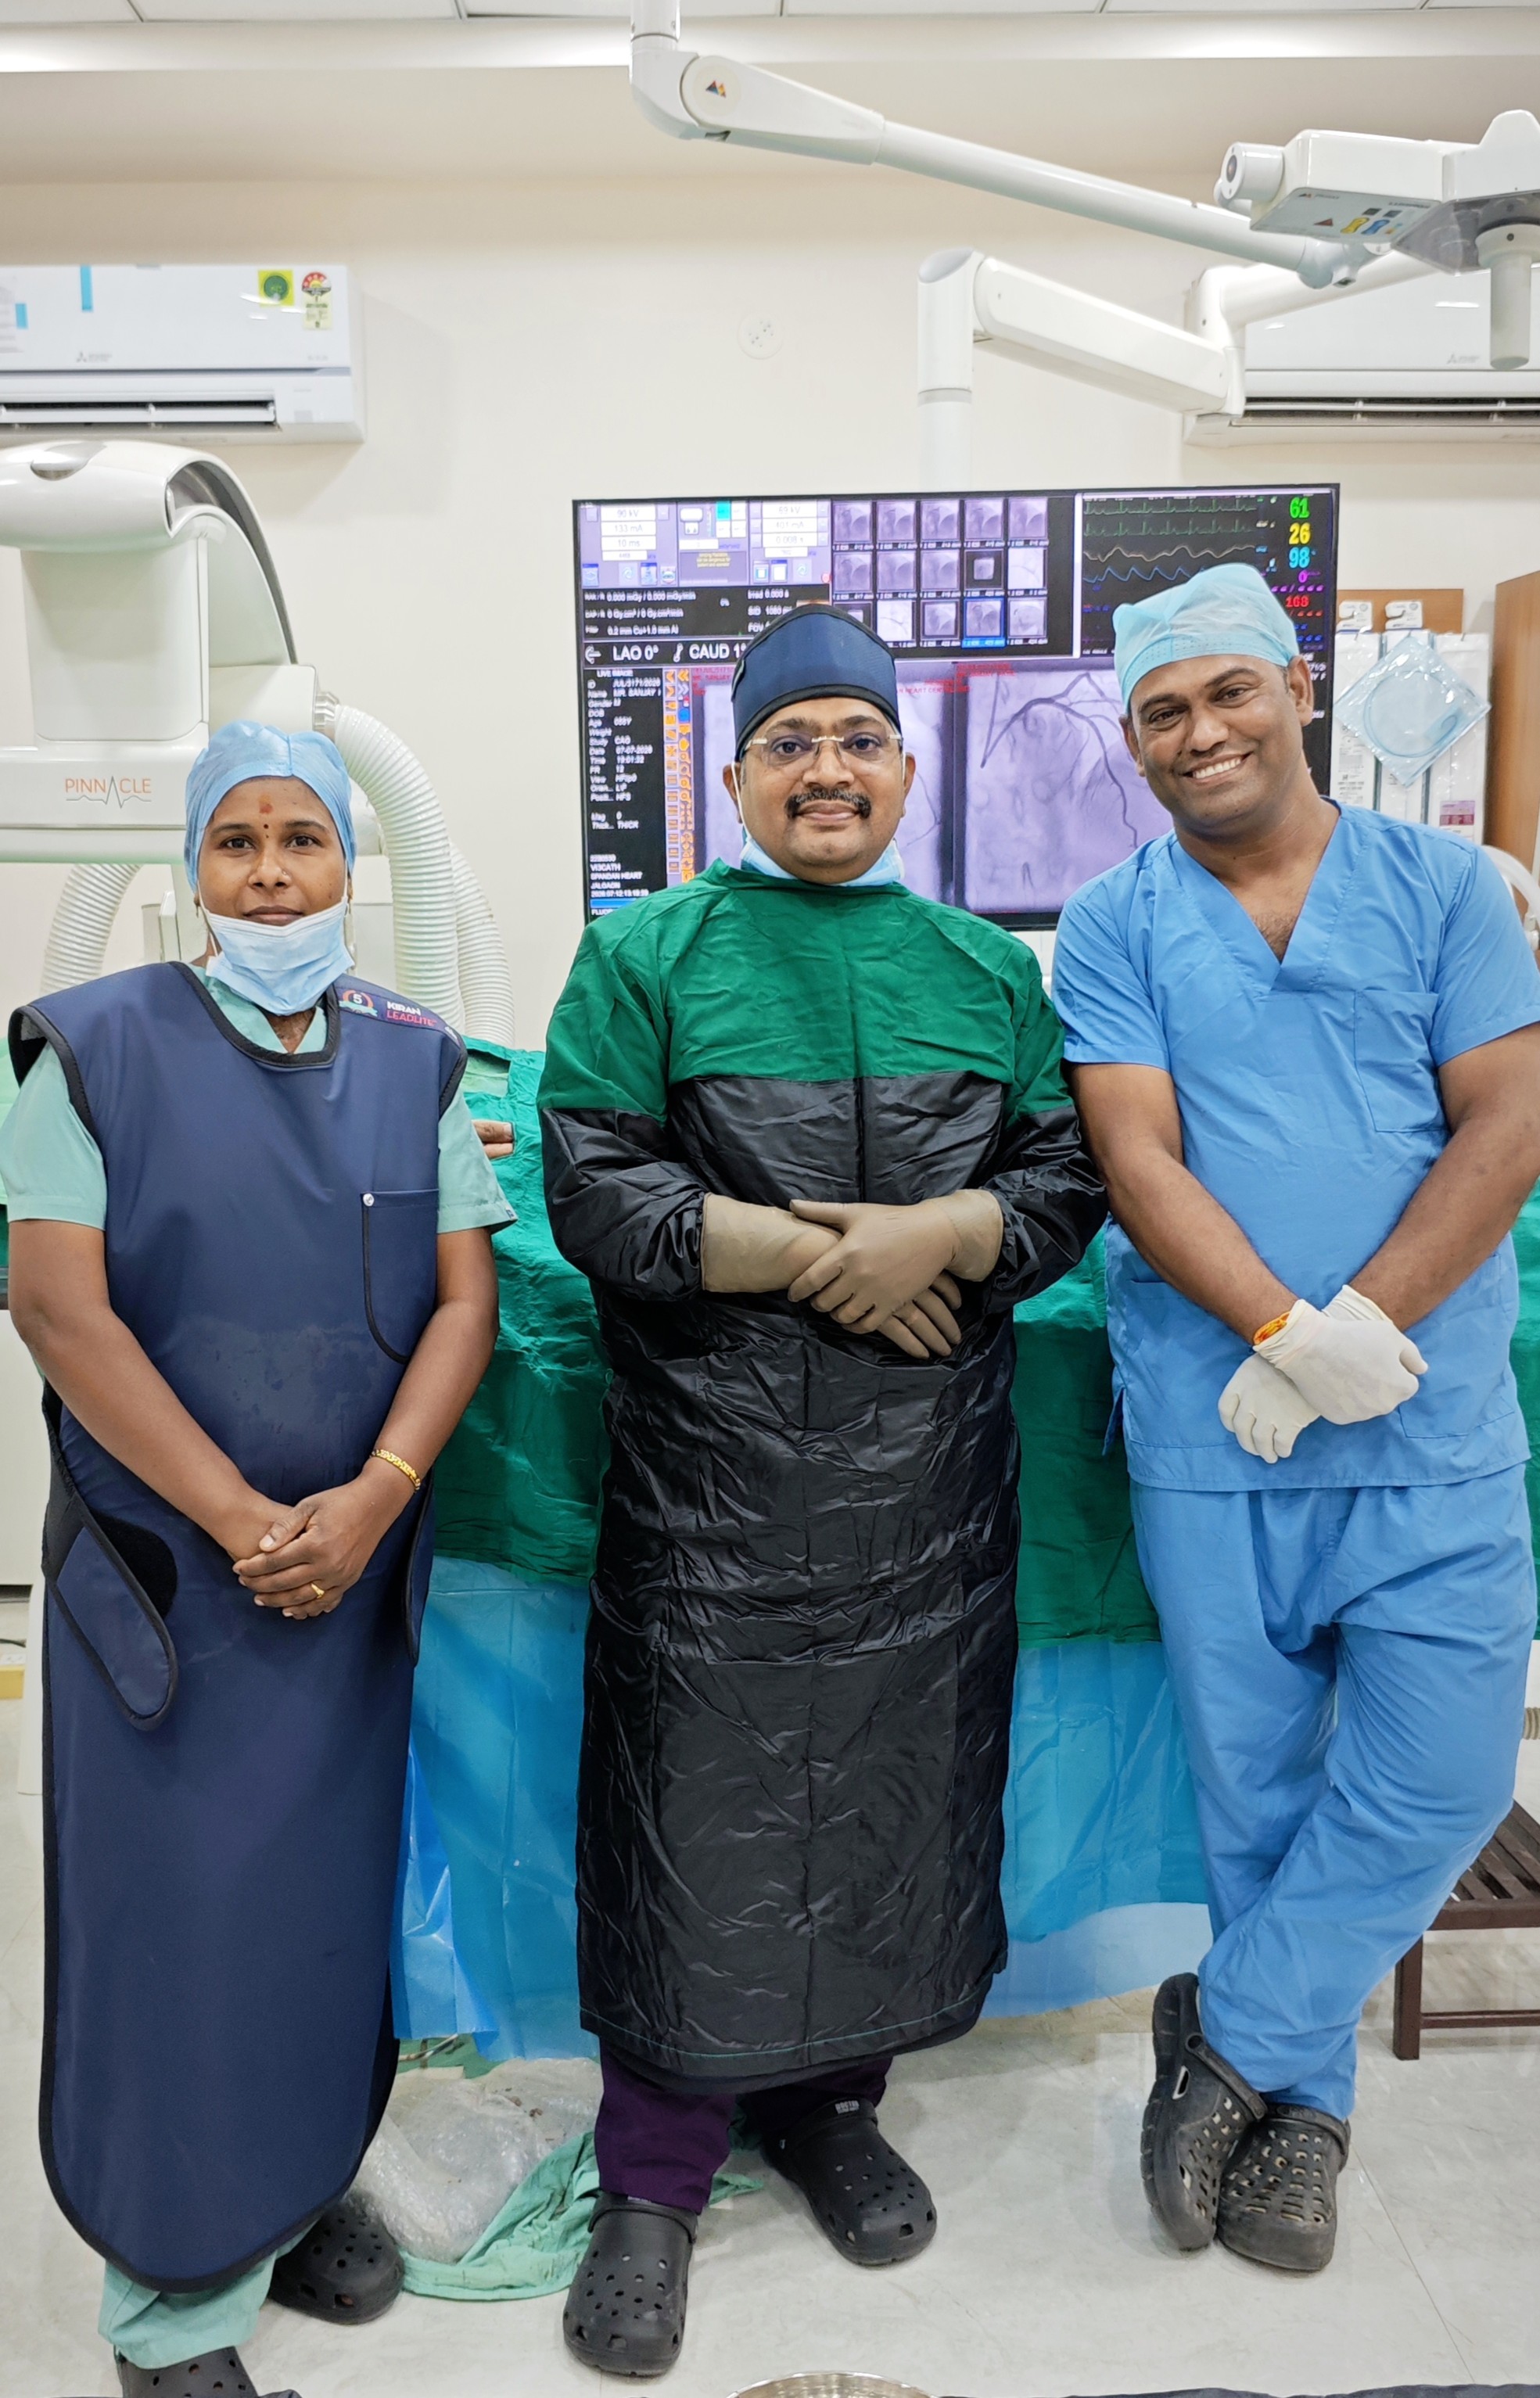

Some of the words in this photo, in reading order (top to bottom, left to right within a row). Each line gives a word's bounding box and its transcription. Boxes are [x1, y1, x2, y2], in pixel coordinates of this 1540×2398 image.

[1290, 497, 1310, 519] 61
[1289, 522, 1311, 544] 26
[1289, 547, 1310, 569] 98
[613, 644, 642, 661] LAO
[689, 644, 730, 659] CAUD
[65, 776, 152, 794] PINNACLE
[353, 993, 363, 1004] 5
[386, 1000, 422, 1016] KIRAN
